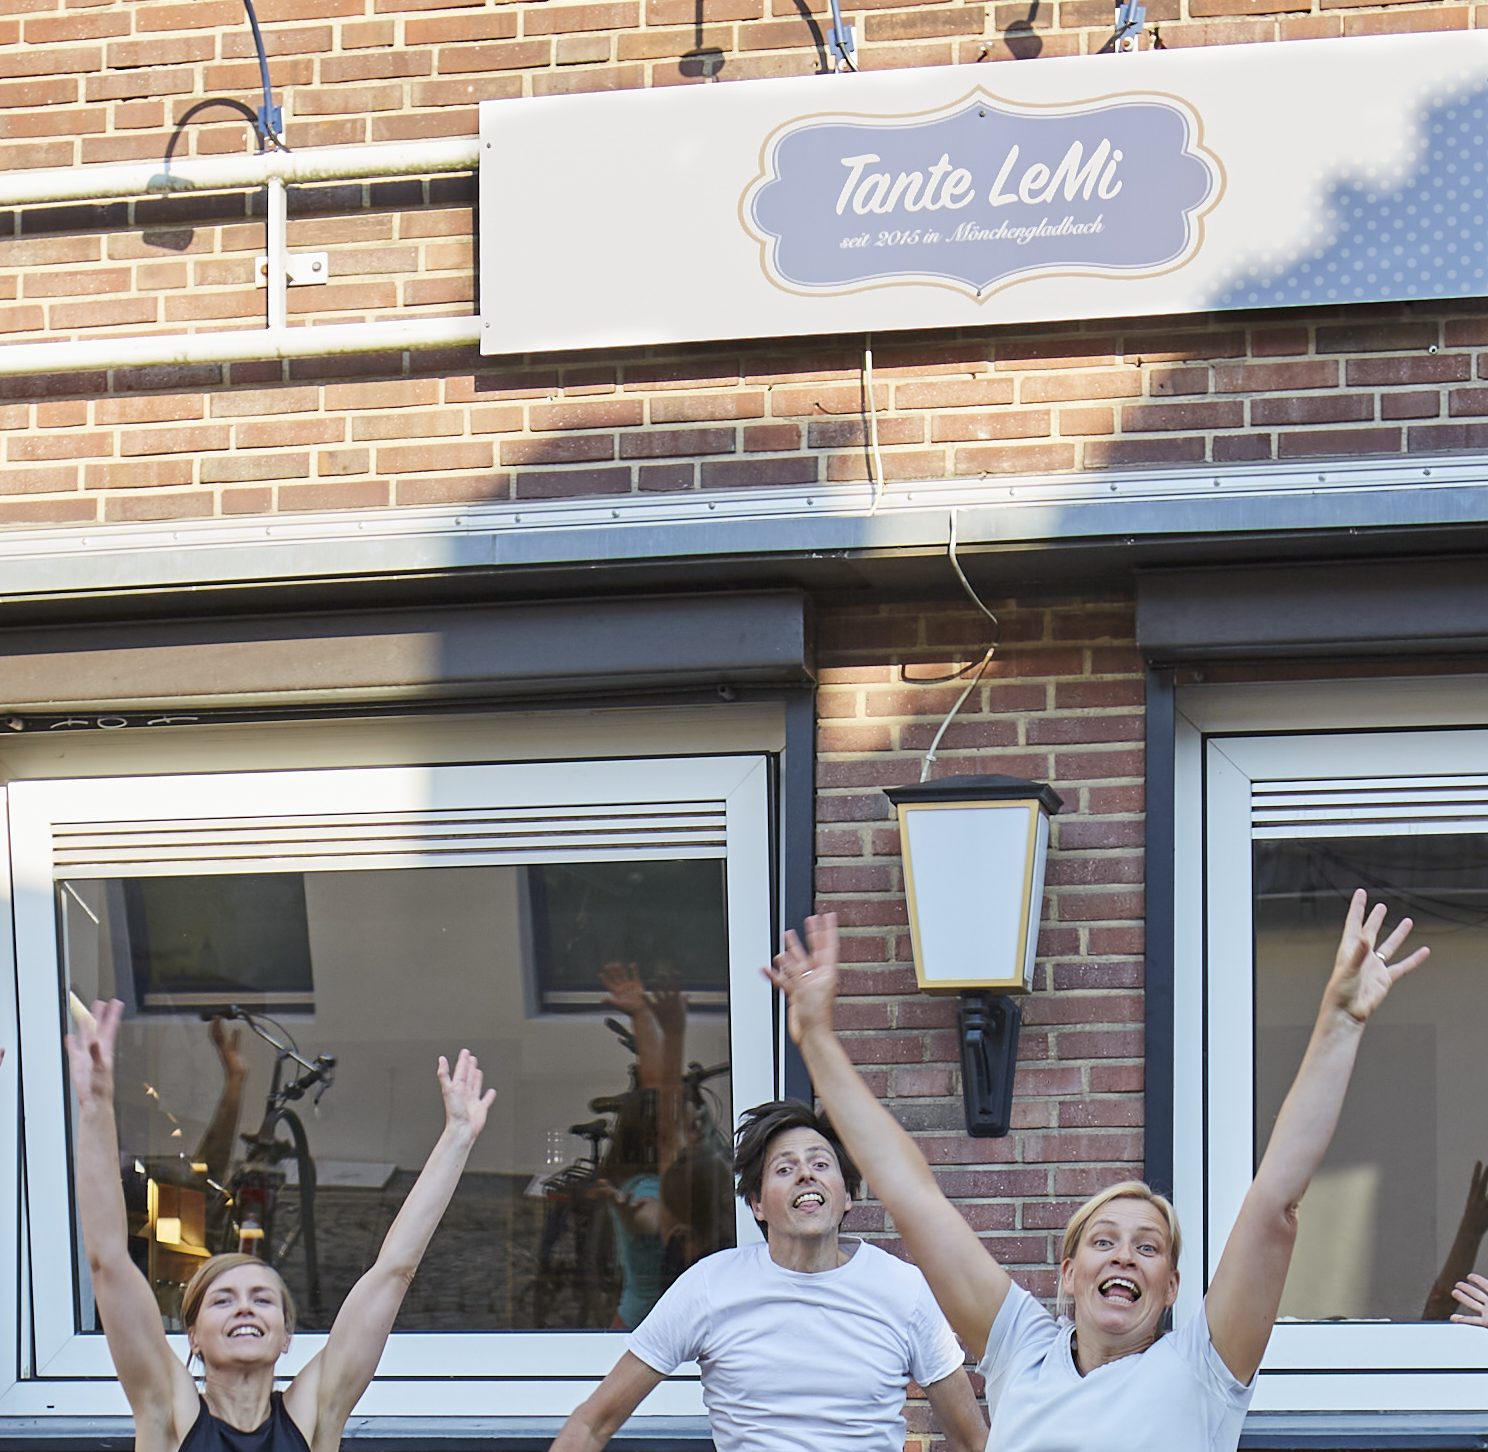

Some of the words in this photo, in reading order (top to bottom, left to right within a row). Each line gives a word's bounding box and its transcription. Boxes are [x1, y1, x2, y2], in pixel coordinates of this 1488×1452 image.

[835, 153, 976, 216] Tante
[988, 137, 1124, 208] LeMi
[840, 231, 873, 249] seit
[873, 229, 921, 247] 2015
[922, 227, 942, 244] in
[945, 214, 1106, 245] Mönchengladbach
